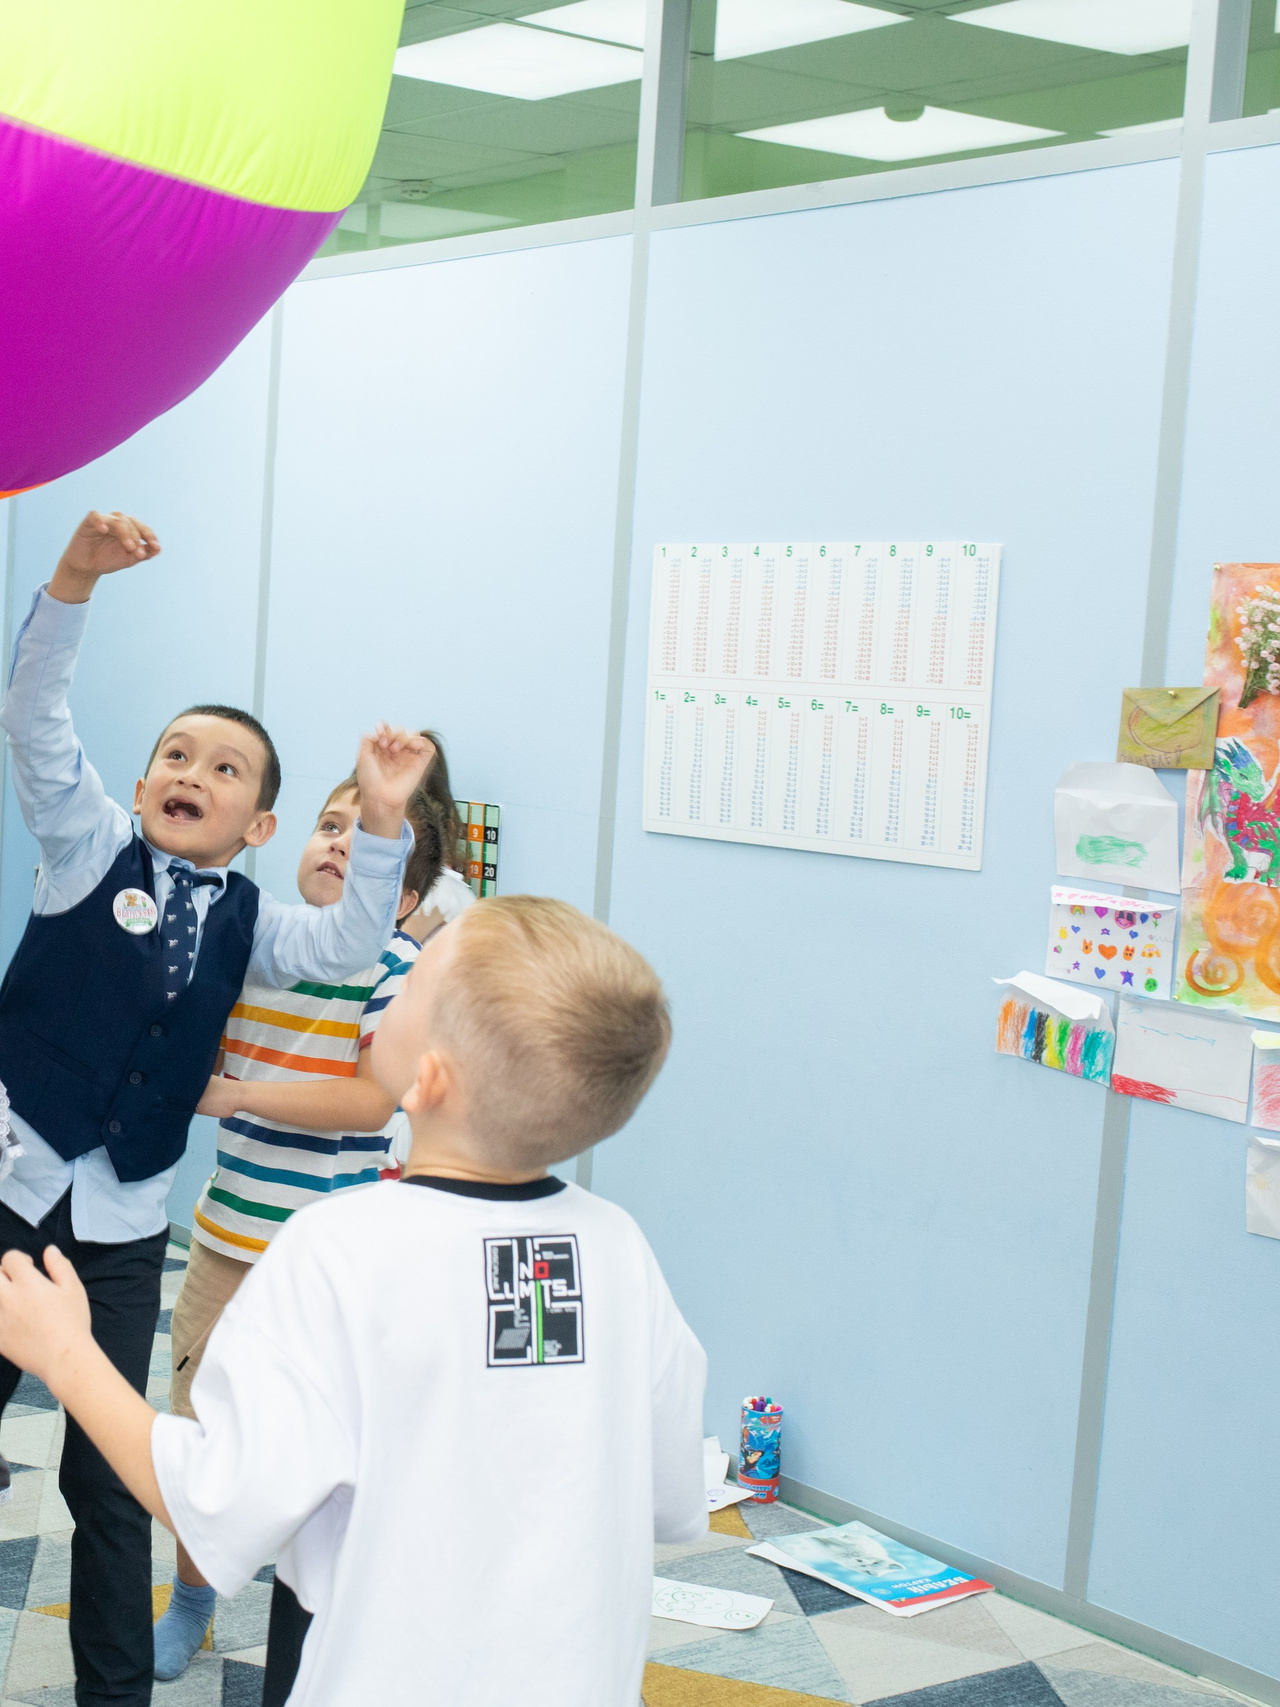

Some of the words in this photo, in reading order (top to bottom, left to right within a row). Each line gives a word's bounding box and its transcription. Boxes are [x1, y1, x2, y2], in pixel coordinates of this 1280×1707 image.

[660, 547, 667, 558] 1
[691, 546, 698, 558] 2
[722, 546, 728, 558] 3
[754, 546, 760, 557] 4
[786, 545, 793, 557] 5
[820, 545, 826, 557] 6
[854, 545, 861, 557] 7
[890, 545, 897, 557] 8
[926, 544, 934, 557] 9
[963, 544, 977, 557] 10
[473, 828, 479, 838] 9
[486, 830, 497, 840] 10
[470, 864, 479, 874] 19
[484, 867, 495, 877] 20
[519, 1254, 550, 1280] NO
[906, 1576, 970, 1594] БЕЛЫЙ
